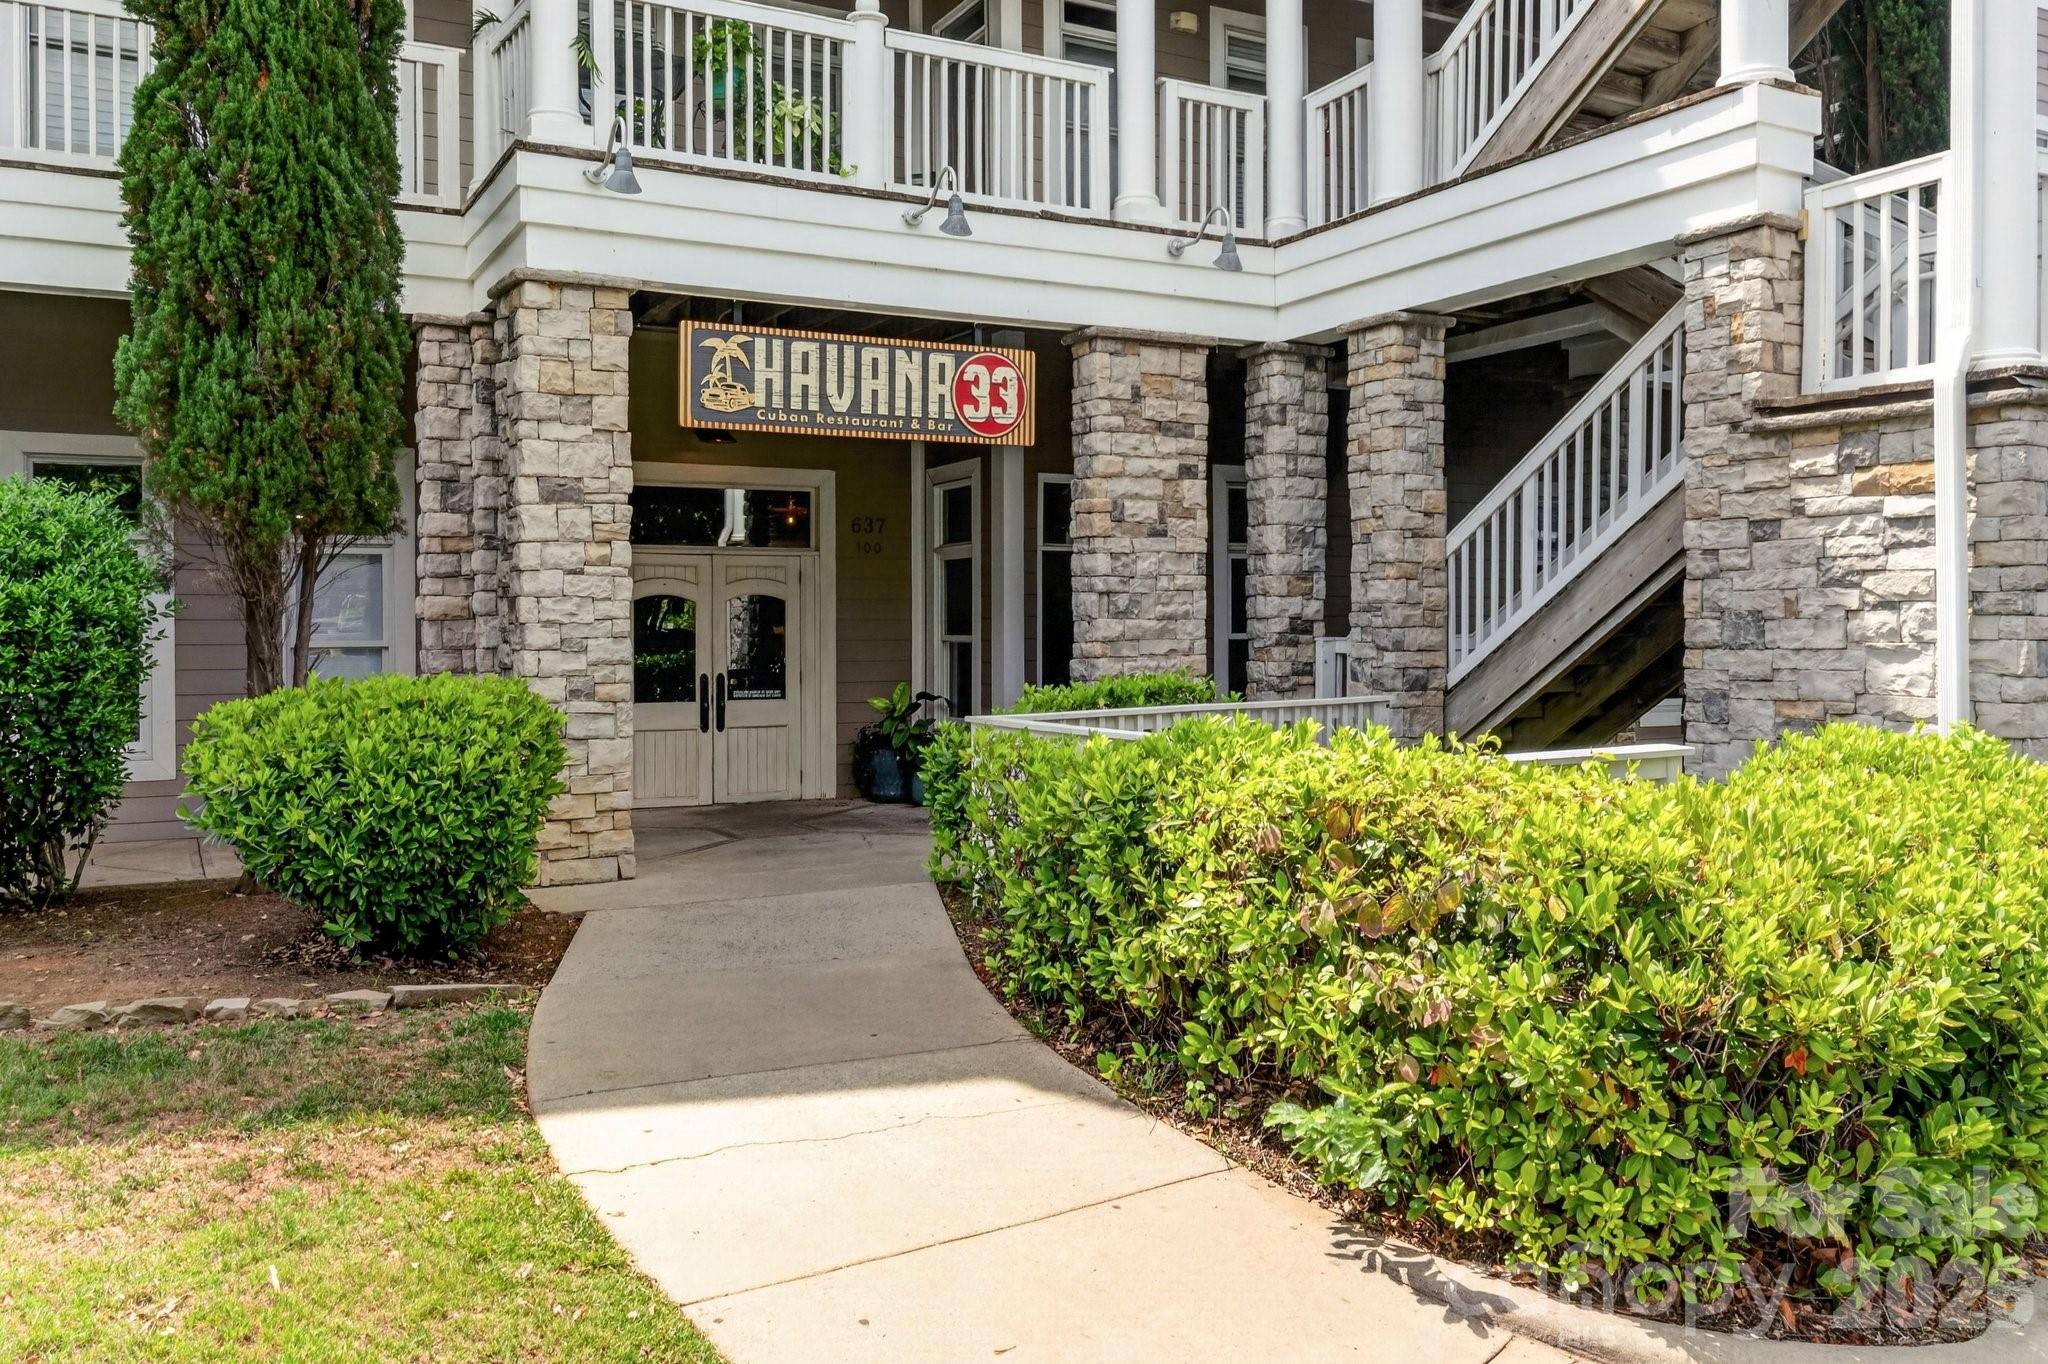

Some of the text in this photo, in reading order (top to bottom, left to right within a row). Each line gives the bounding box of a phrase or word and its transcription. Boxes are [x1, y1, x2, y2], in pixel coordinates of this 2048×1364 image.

[754, 337, 1018, 424] HAVANA 33
[756, 408, 954, 431] Cuban Restaurant & Bar
[851, 516, 886, 534] 637
[857, 542, 882, 554] 100
